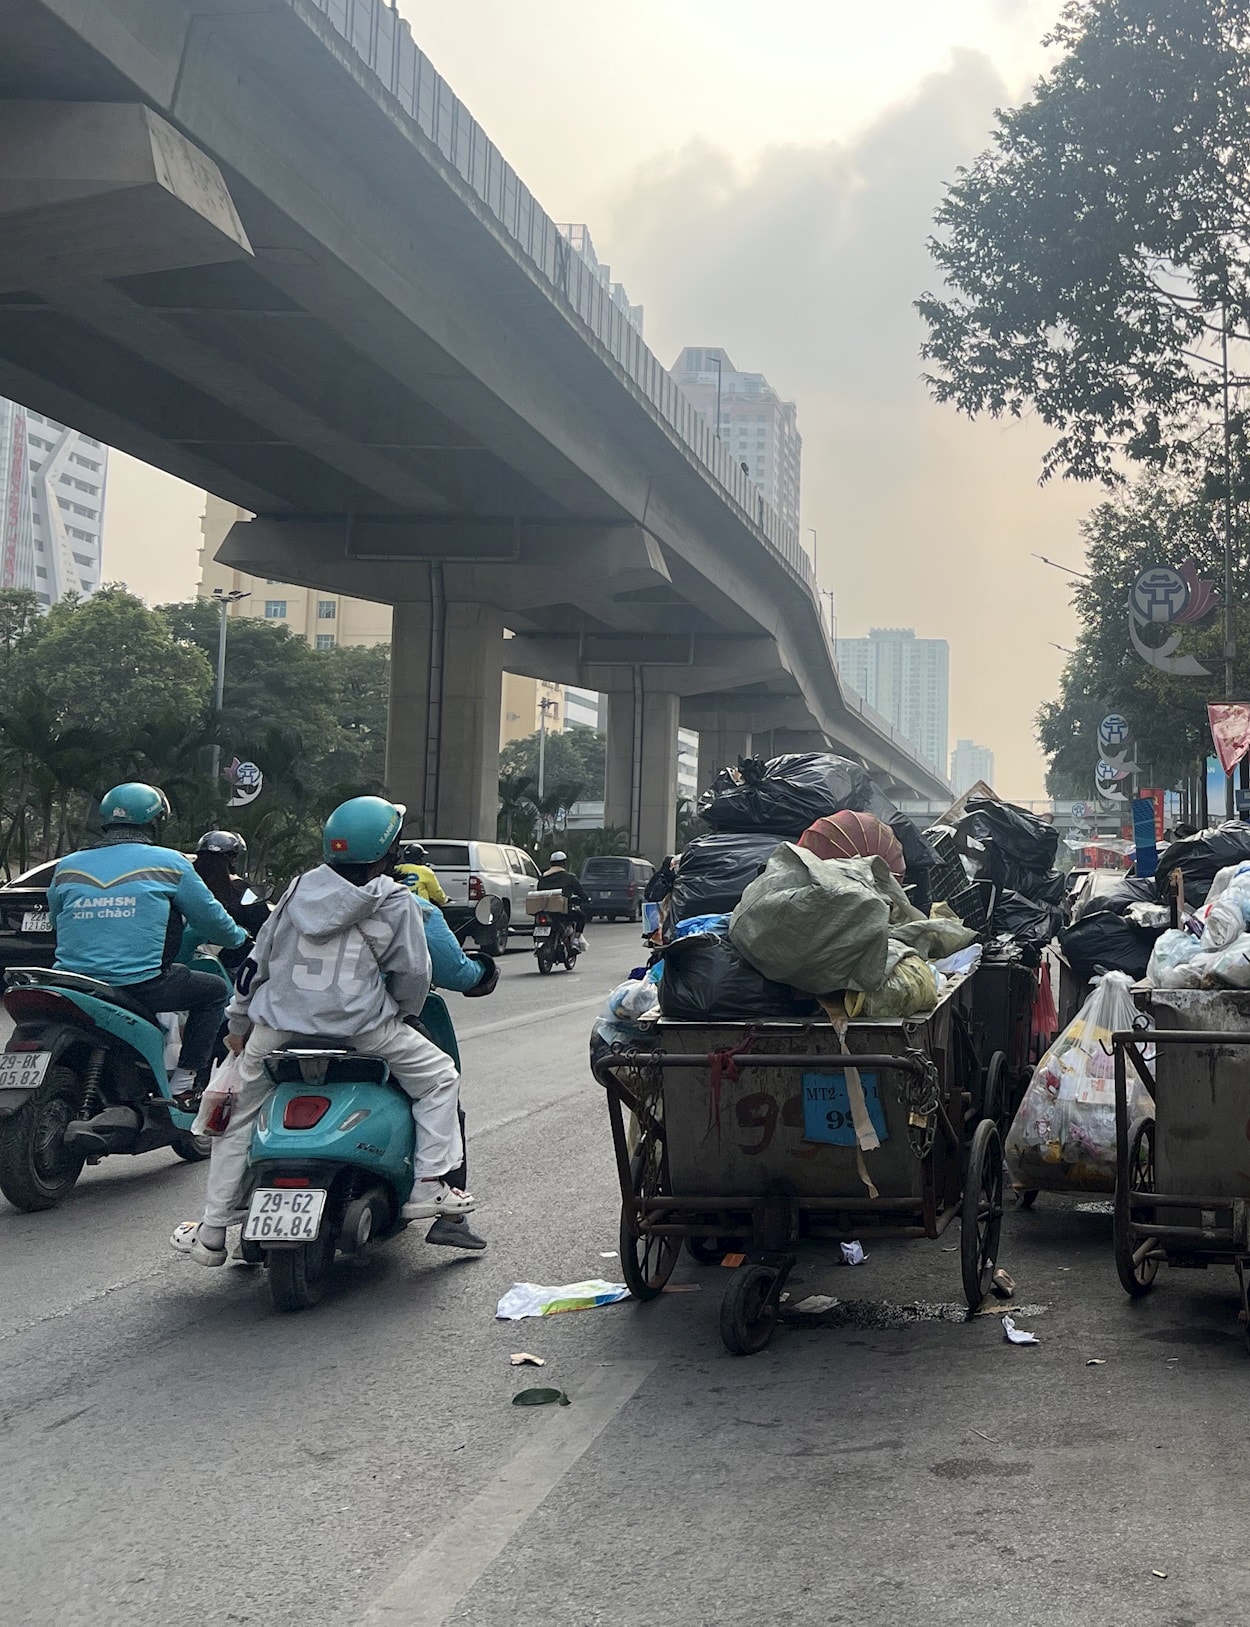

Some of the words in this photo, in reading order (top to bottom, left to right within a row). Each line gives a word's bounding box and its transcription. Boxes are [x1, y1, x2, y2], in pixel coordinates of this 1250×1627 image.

[73, 911, 93, 919] xin
[97, 907, 136, 919] chào!
[260, 1193, 314, 1213] 29-G2
[252, 1216, 313, 1237] 164.84
